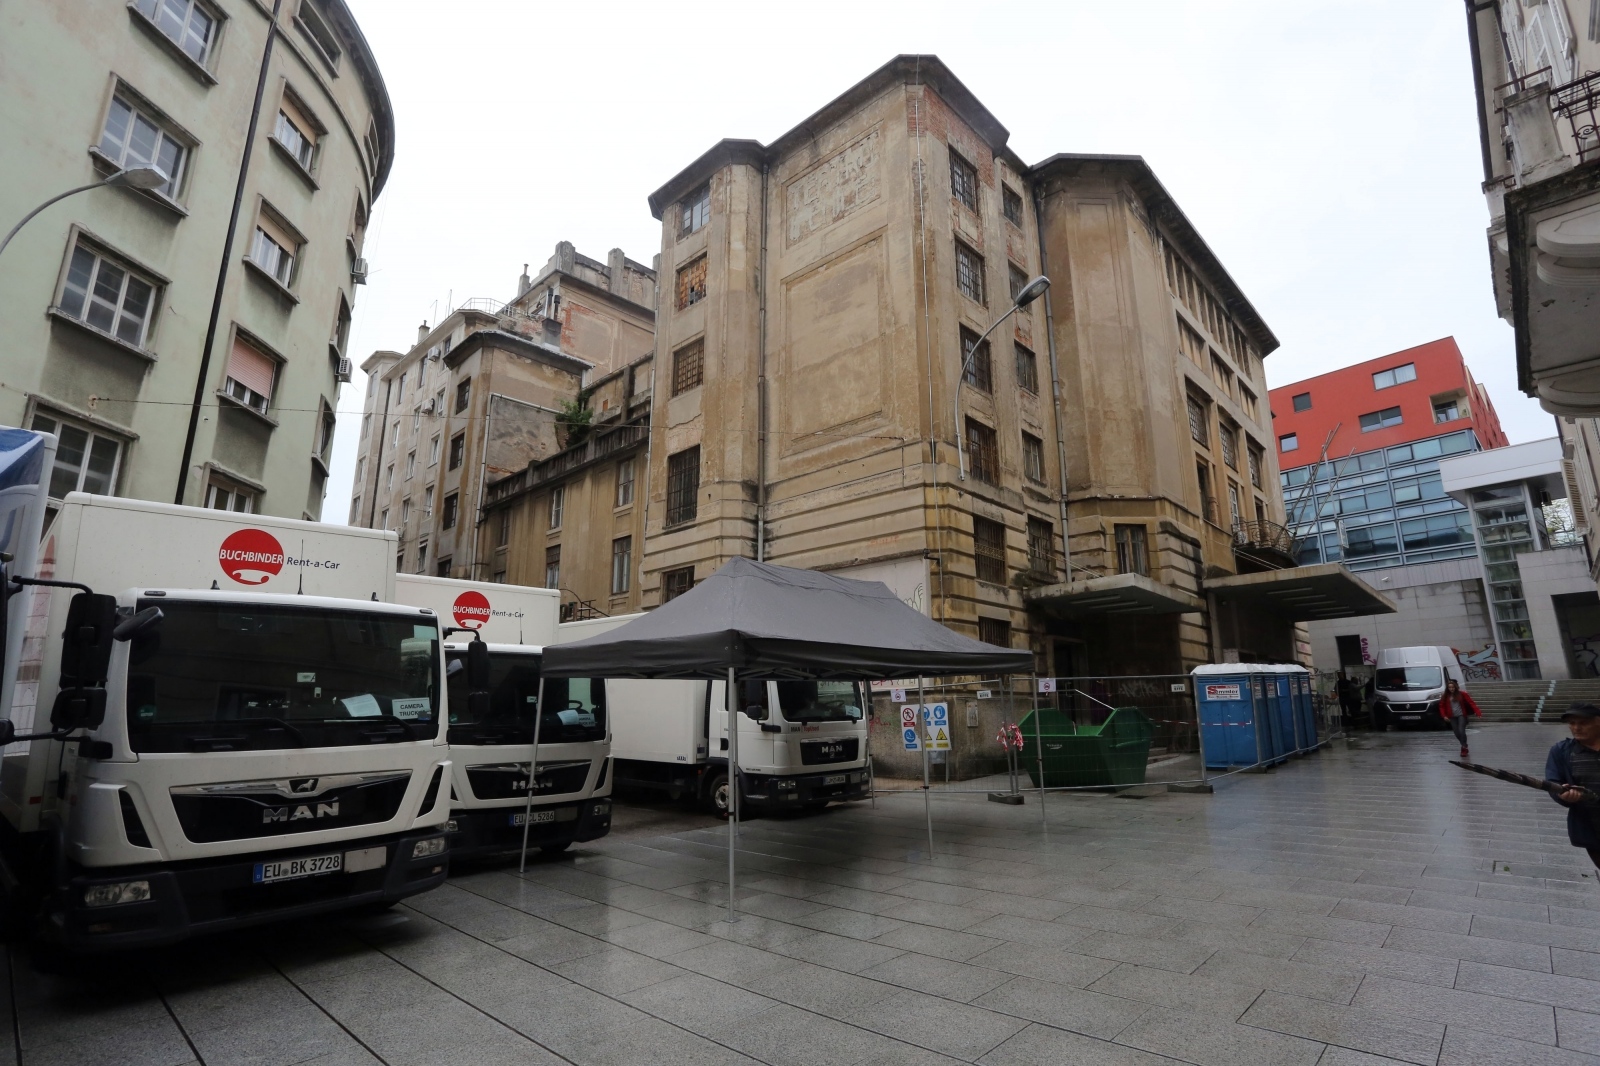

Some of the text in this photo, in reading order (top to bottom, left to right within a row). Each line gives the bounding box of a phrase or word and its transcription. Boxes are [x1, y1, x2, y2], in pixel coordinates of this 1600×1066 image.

[220, 549, 340, 569] BUCHBINDER Rent-a-Car
[453, 606, 524, 618] BUCHBINDER Rent-a-Car
[821, 745, 843, 753] MAN
[513, 780, 552, 790] MAN
[263, 802, 339, 823] MAN
[263, 863, 282, 879] EU
[290, 860, 308, 875] BK
[310, 855, 340, 871] 3728
